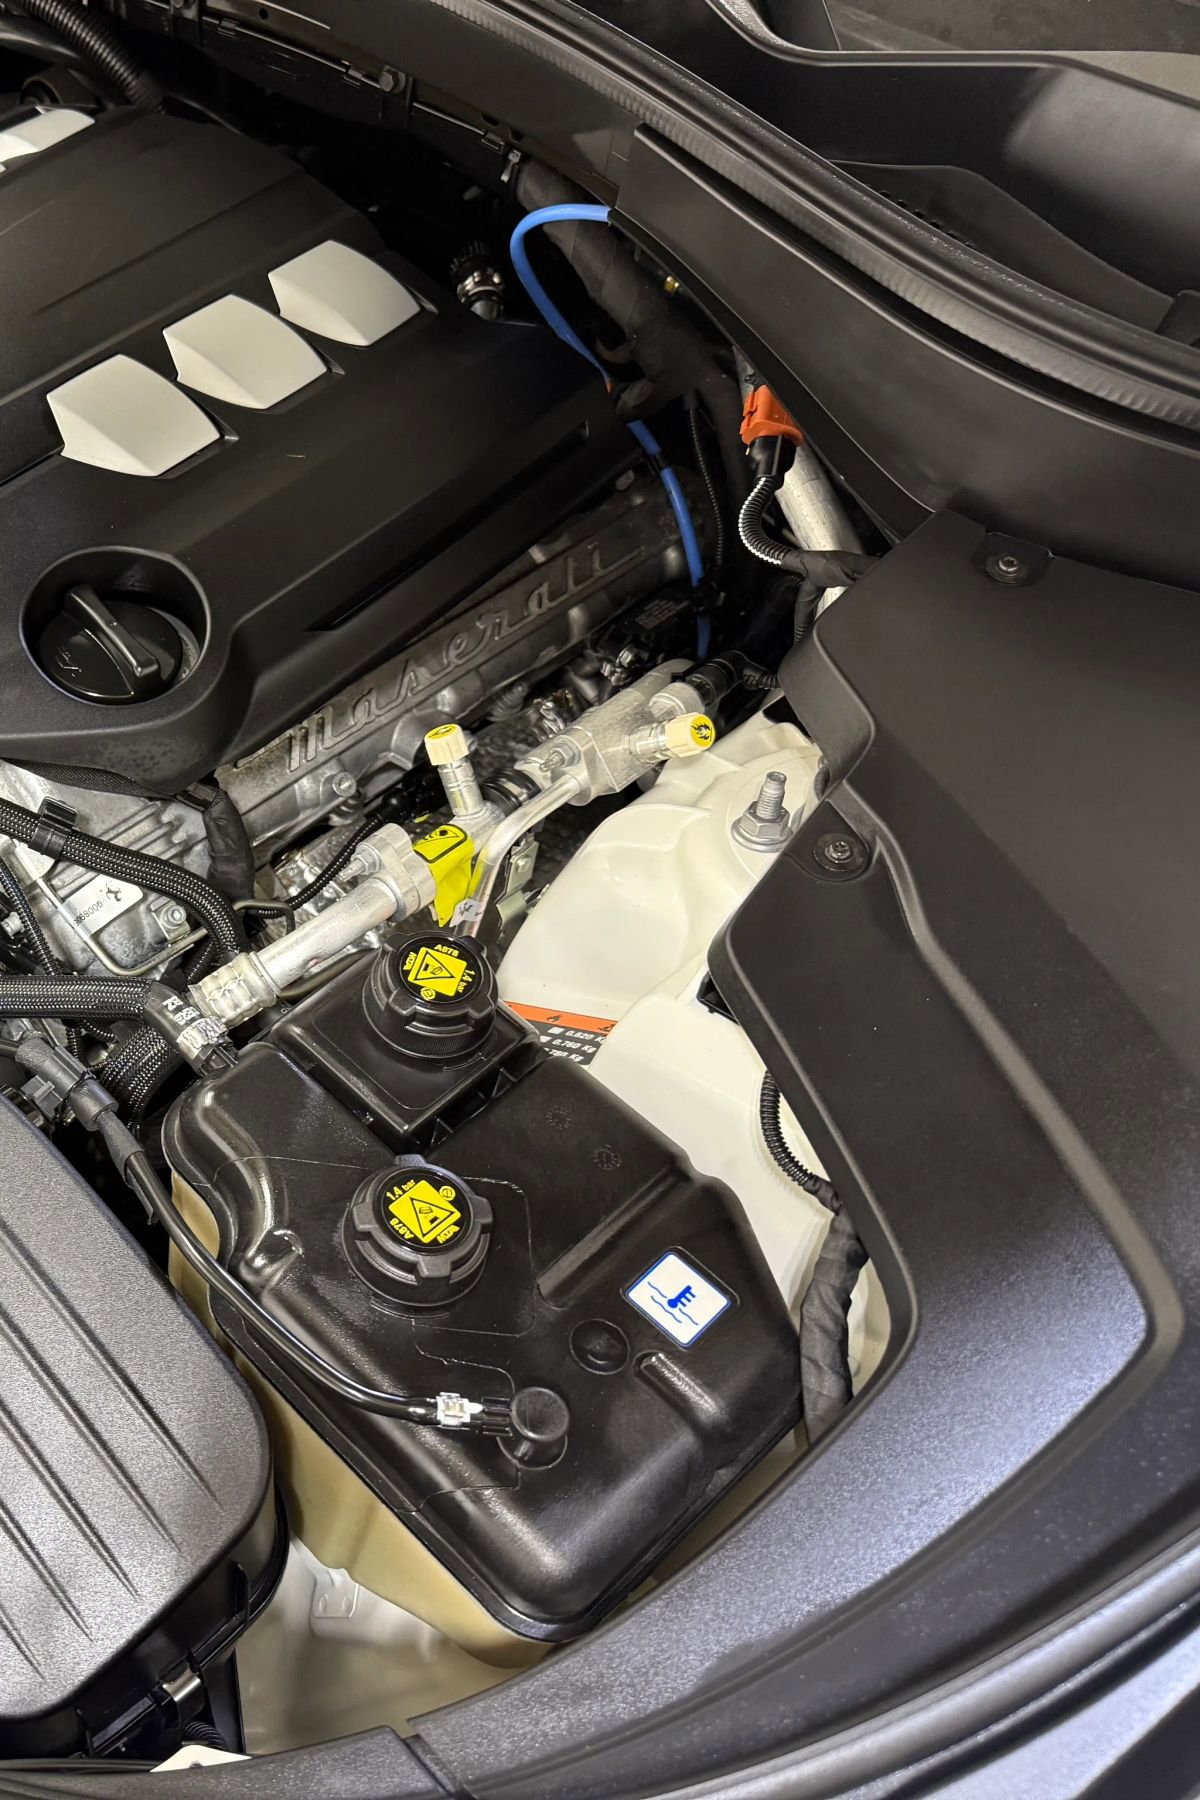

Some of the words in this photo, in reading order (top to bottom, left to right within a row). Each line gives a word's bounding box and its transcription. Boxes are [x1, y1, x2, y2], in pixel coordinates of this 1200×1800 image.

[233, 543, 647, 773] Maserati
[462, 969, 476, 982] 1.4
[457, 981, 468, 993] bar
[581, 1044, 597, 1054] Kg
[386, 1186, 403, 1200] 1.4
[401, 1179, 416, 1191] bar
